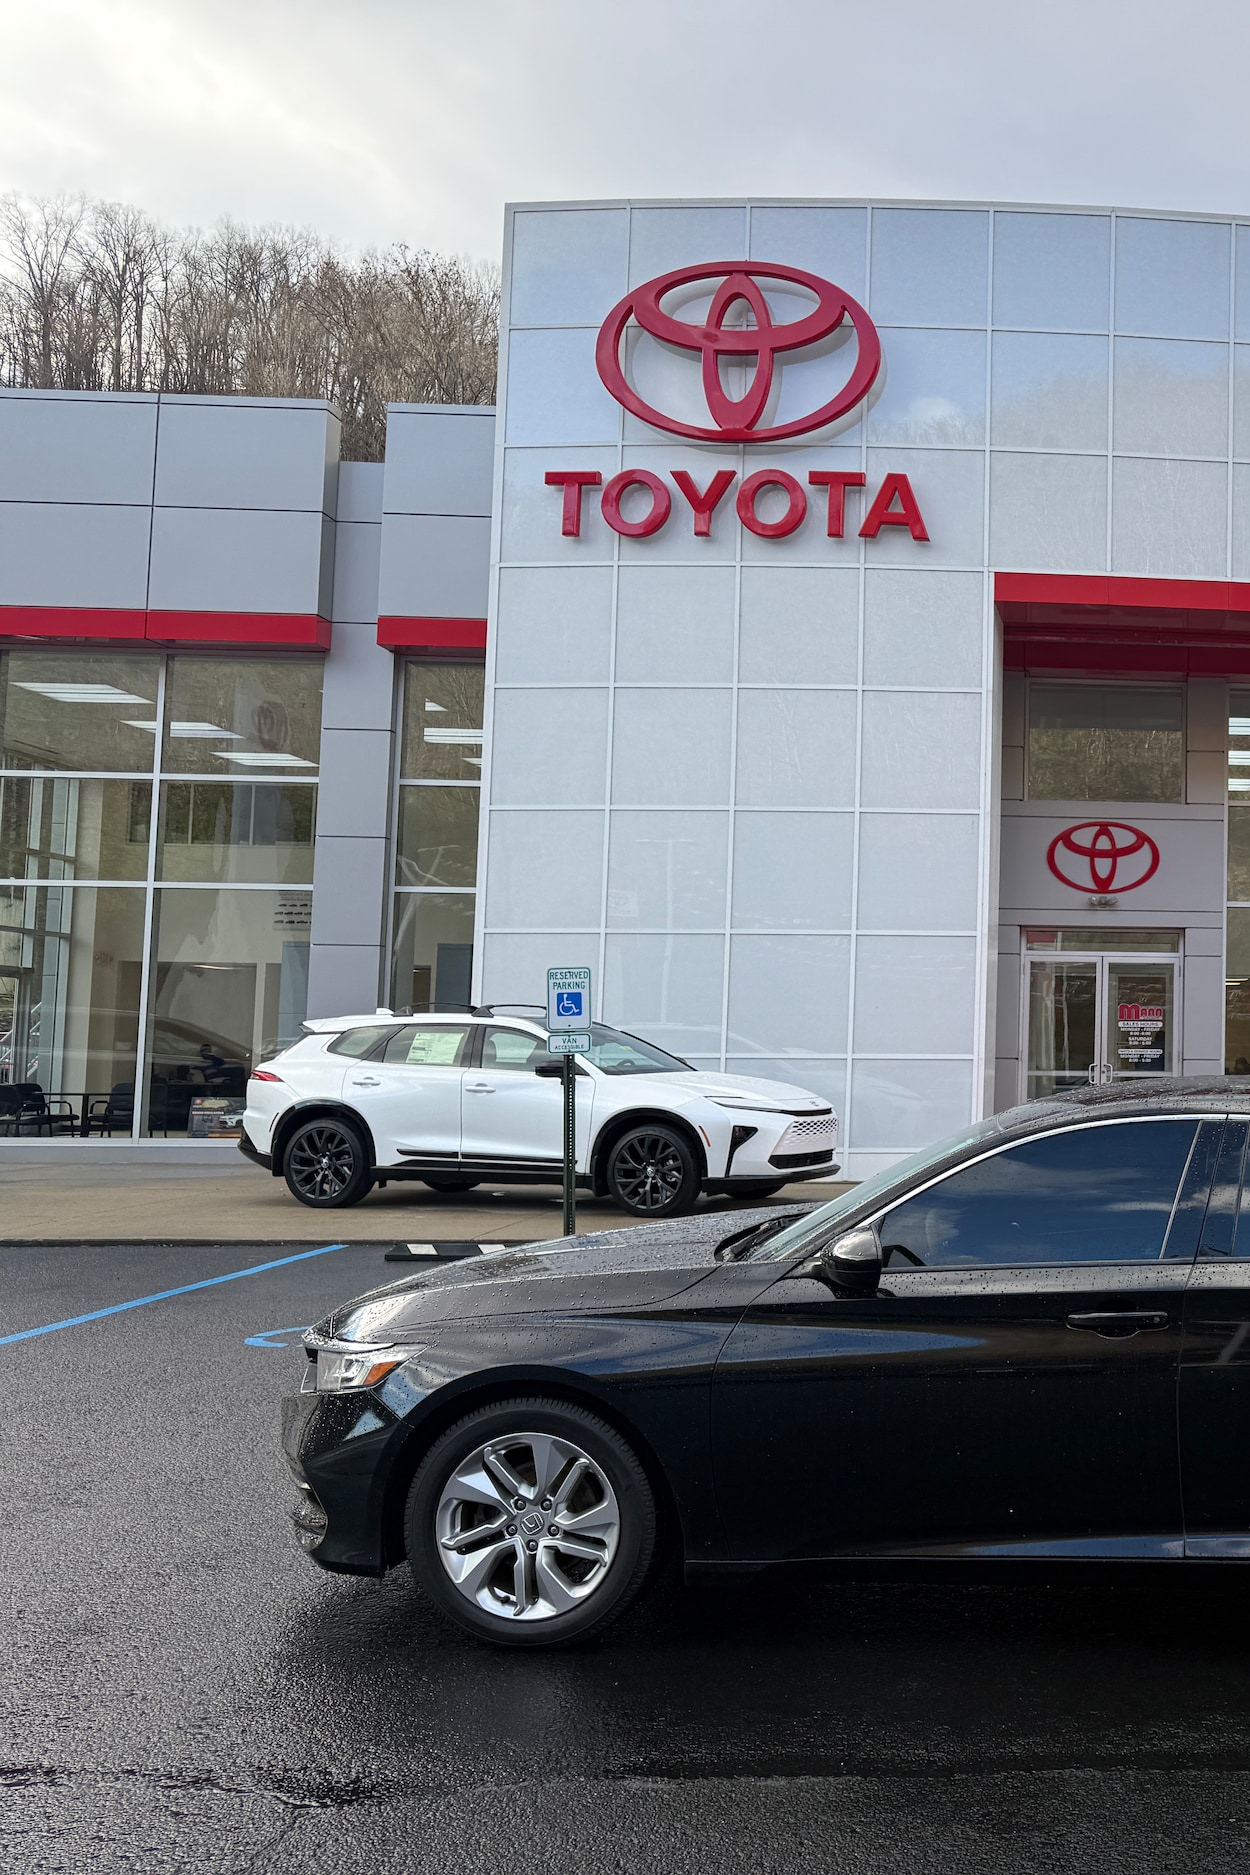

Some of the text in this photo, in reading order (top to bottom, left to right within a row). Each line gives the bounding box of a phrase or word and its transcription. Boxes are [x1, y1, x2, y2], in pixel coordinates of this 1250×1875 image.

[544, 468, 930, 542] TOYOTA
[549, 971, 588, 980] RESERVED
[553, 981, 586, 990] PARKING
